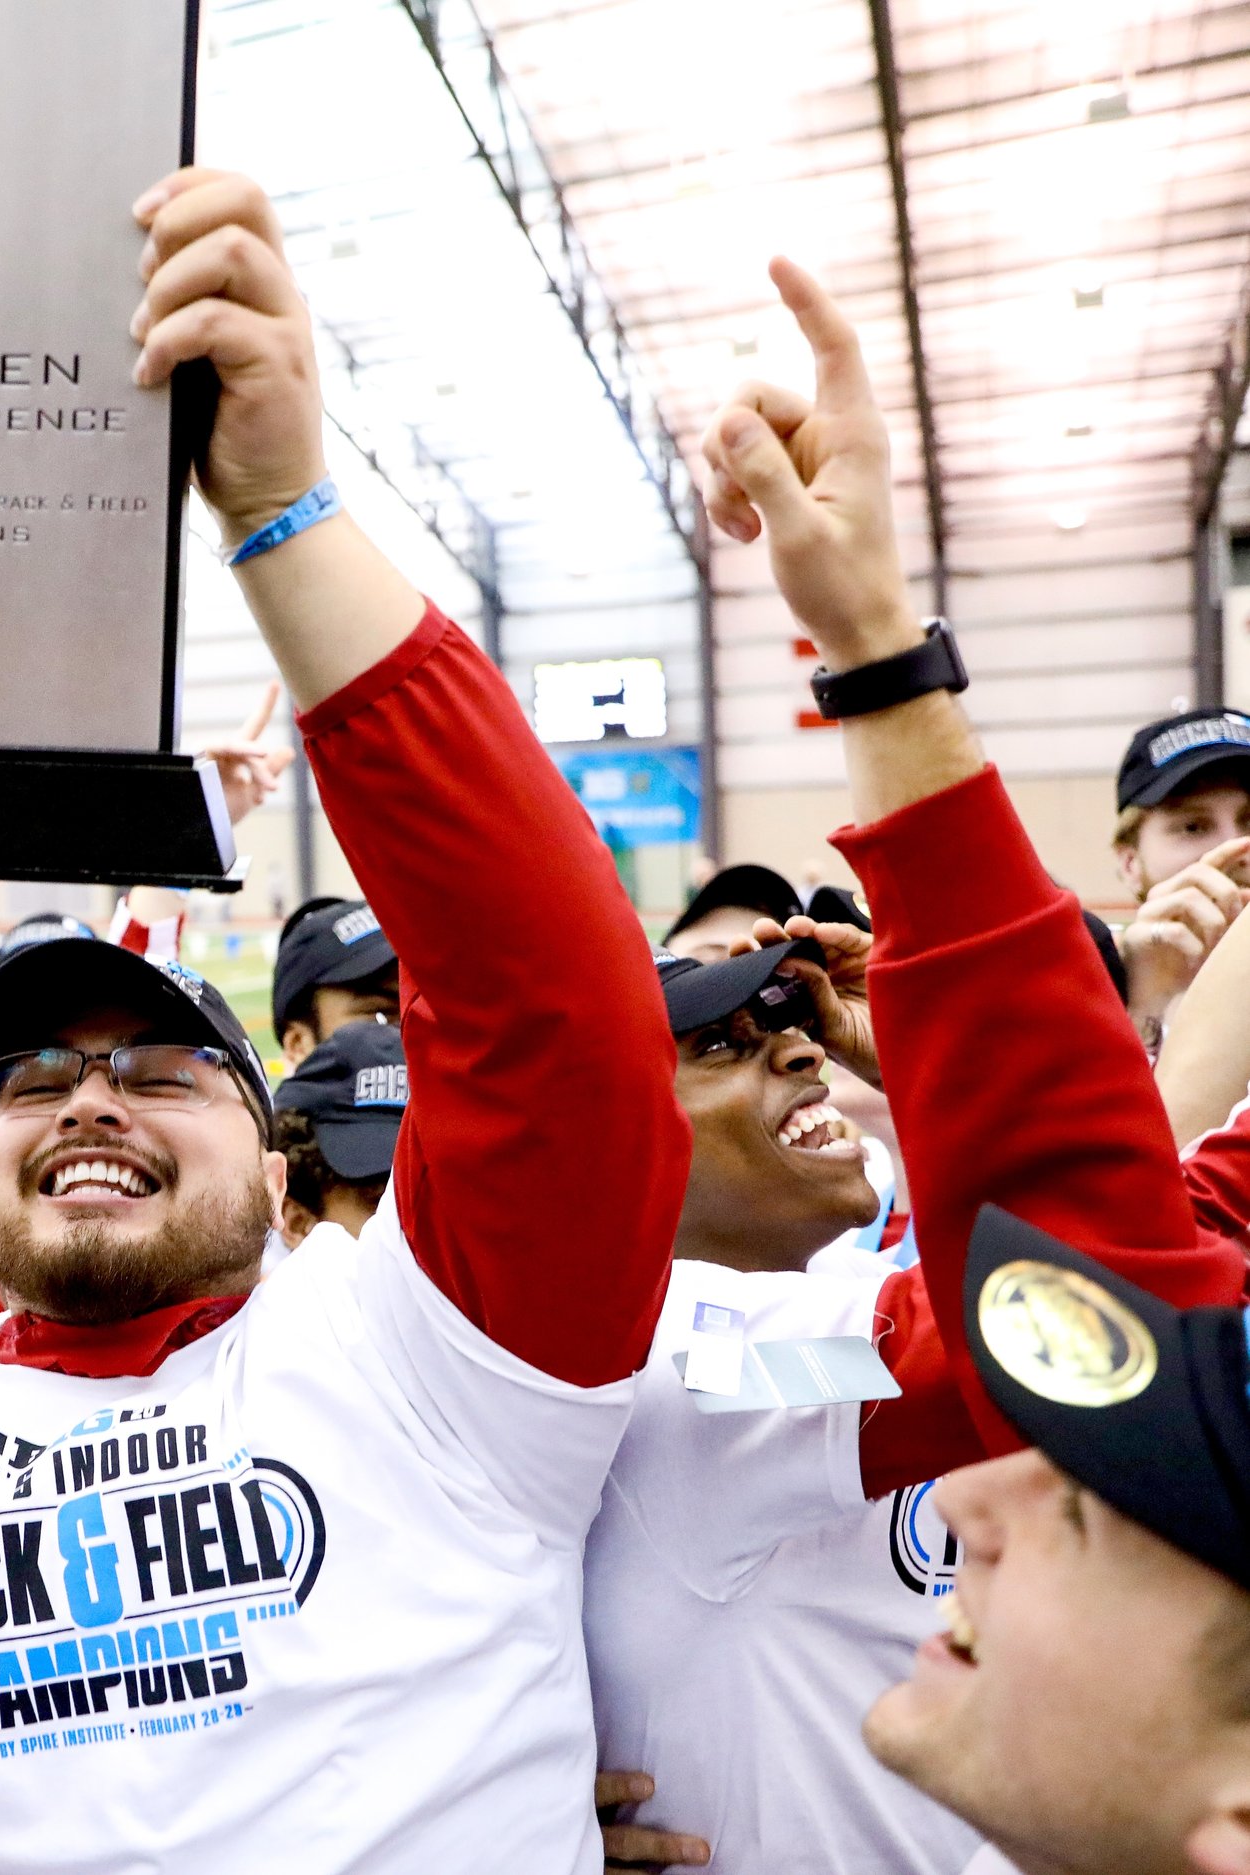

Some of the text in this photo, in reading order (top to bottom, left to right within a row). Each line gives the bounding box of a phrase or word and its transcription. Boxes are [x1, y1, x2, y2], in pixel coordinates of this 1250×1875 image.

[87, 494, 148, 513] FIELD
[52, 1424, 207, 1496] INDOOR
[56, 1491, 125, 1628] &
[0, 1740, 15, 1758] BY
[20, 1732, 58, 1754] SPIRE
[62, 1722, 126, 1748] INSTITUTE
[138, 1711, 197, 1738] FEBRUARY
